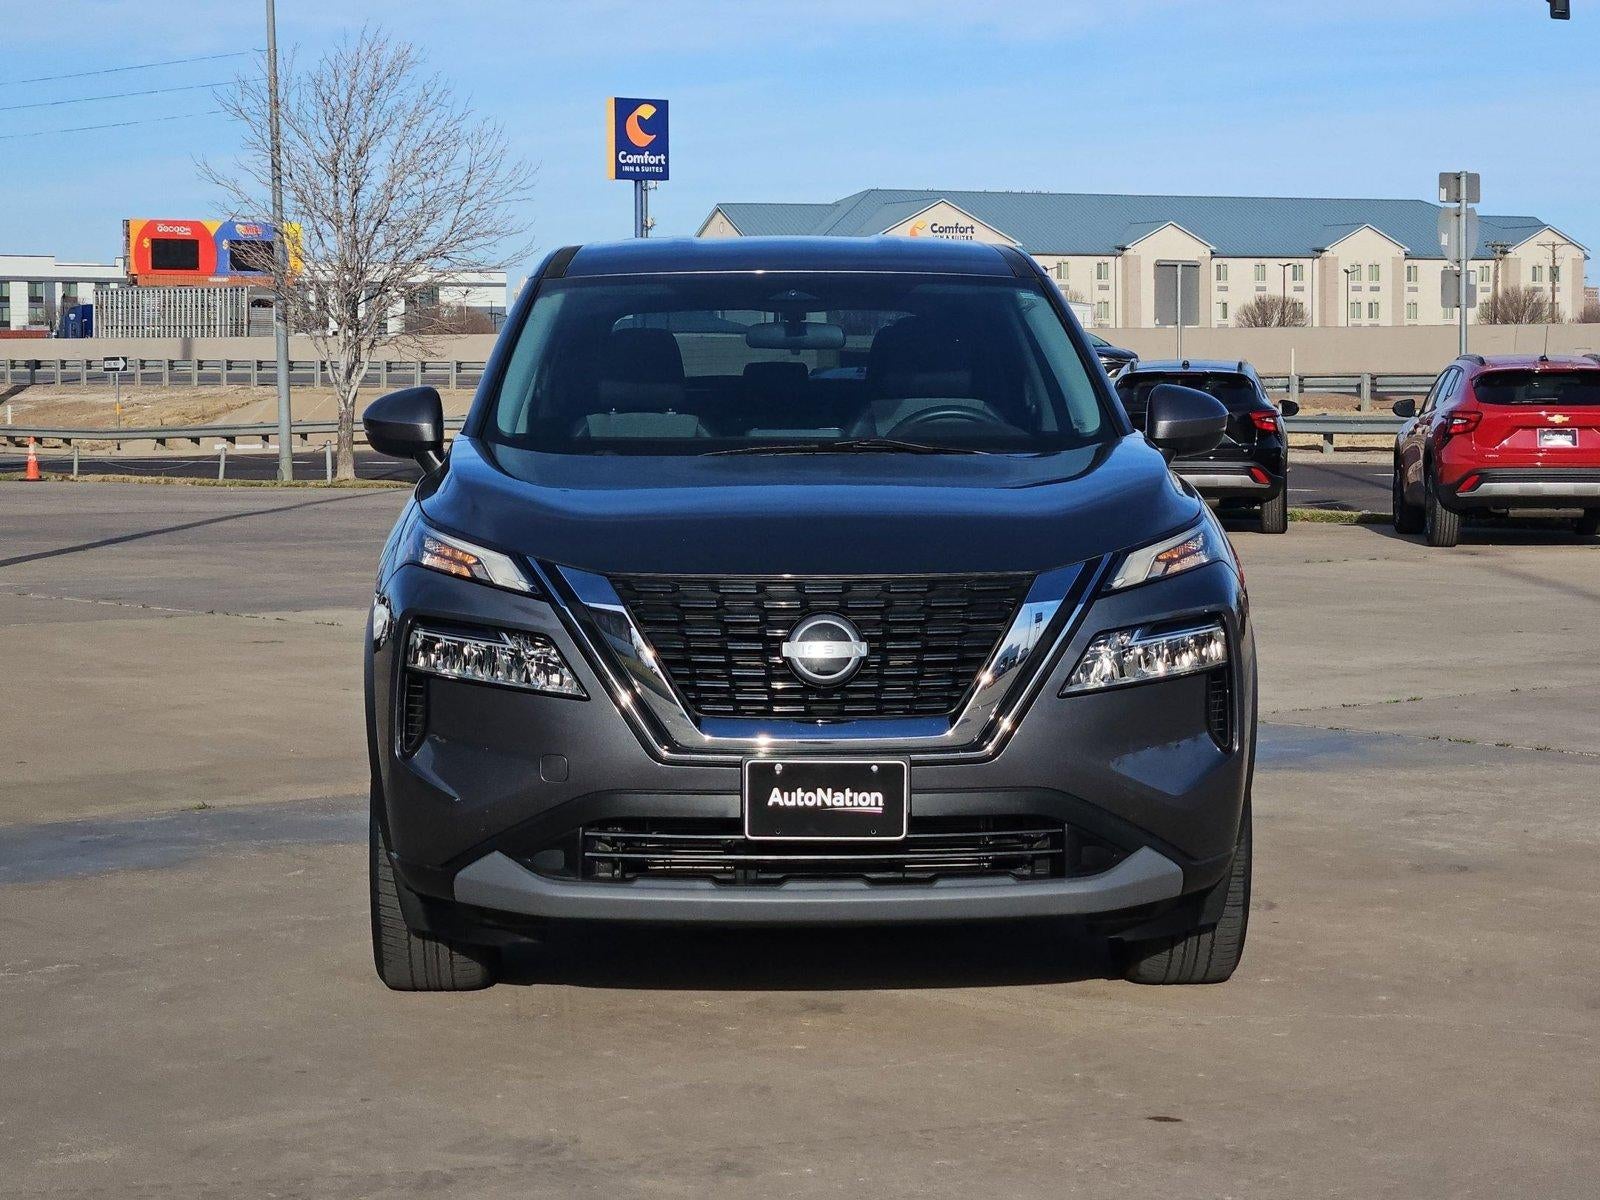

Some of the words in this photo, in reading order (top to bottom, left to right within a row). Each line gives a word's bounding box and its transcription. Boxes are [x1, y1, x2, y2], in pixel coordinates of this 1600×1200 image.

[618, 150, 666, 165] Comfort
[930, 222, 975, 234] Comfort
[767, 787, 884, 807] AutoNation
